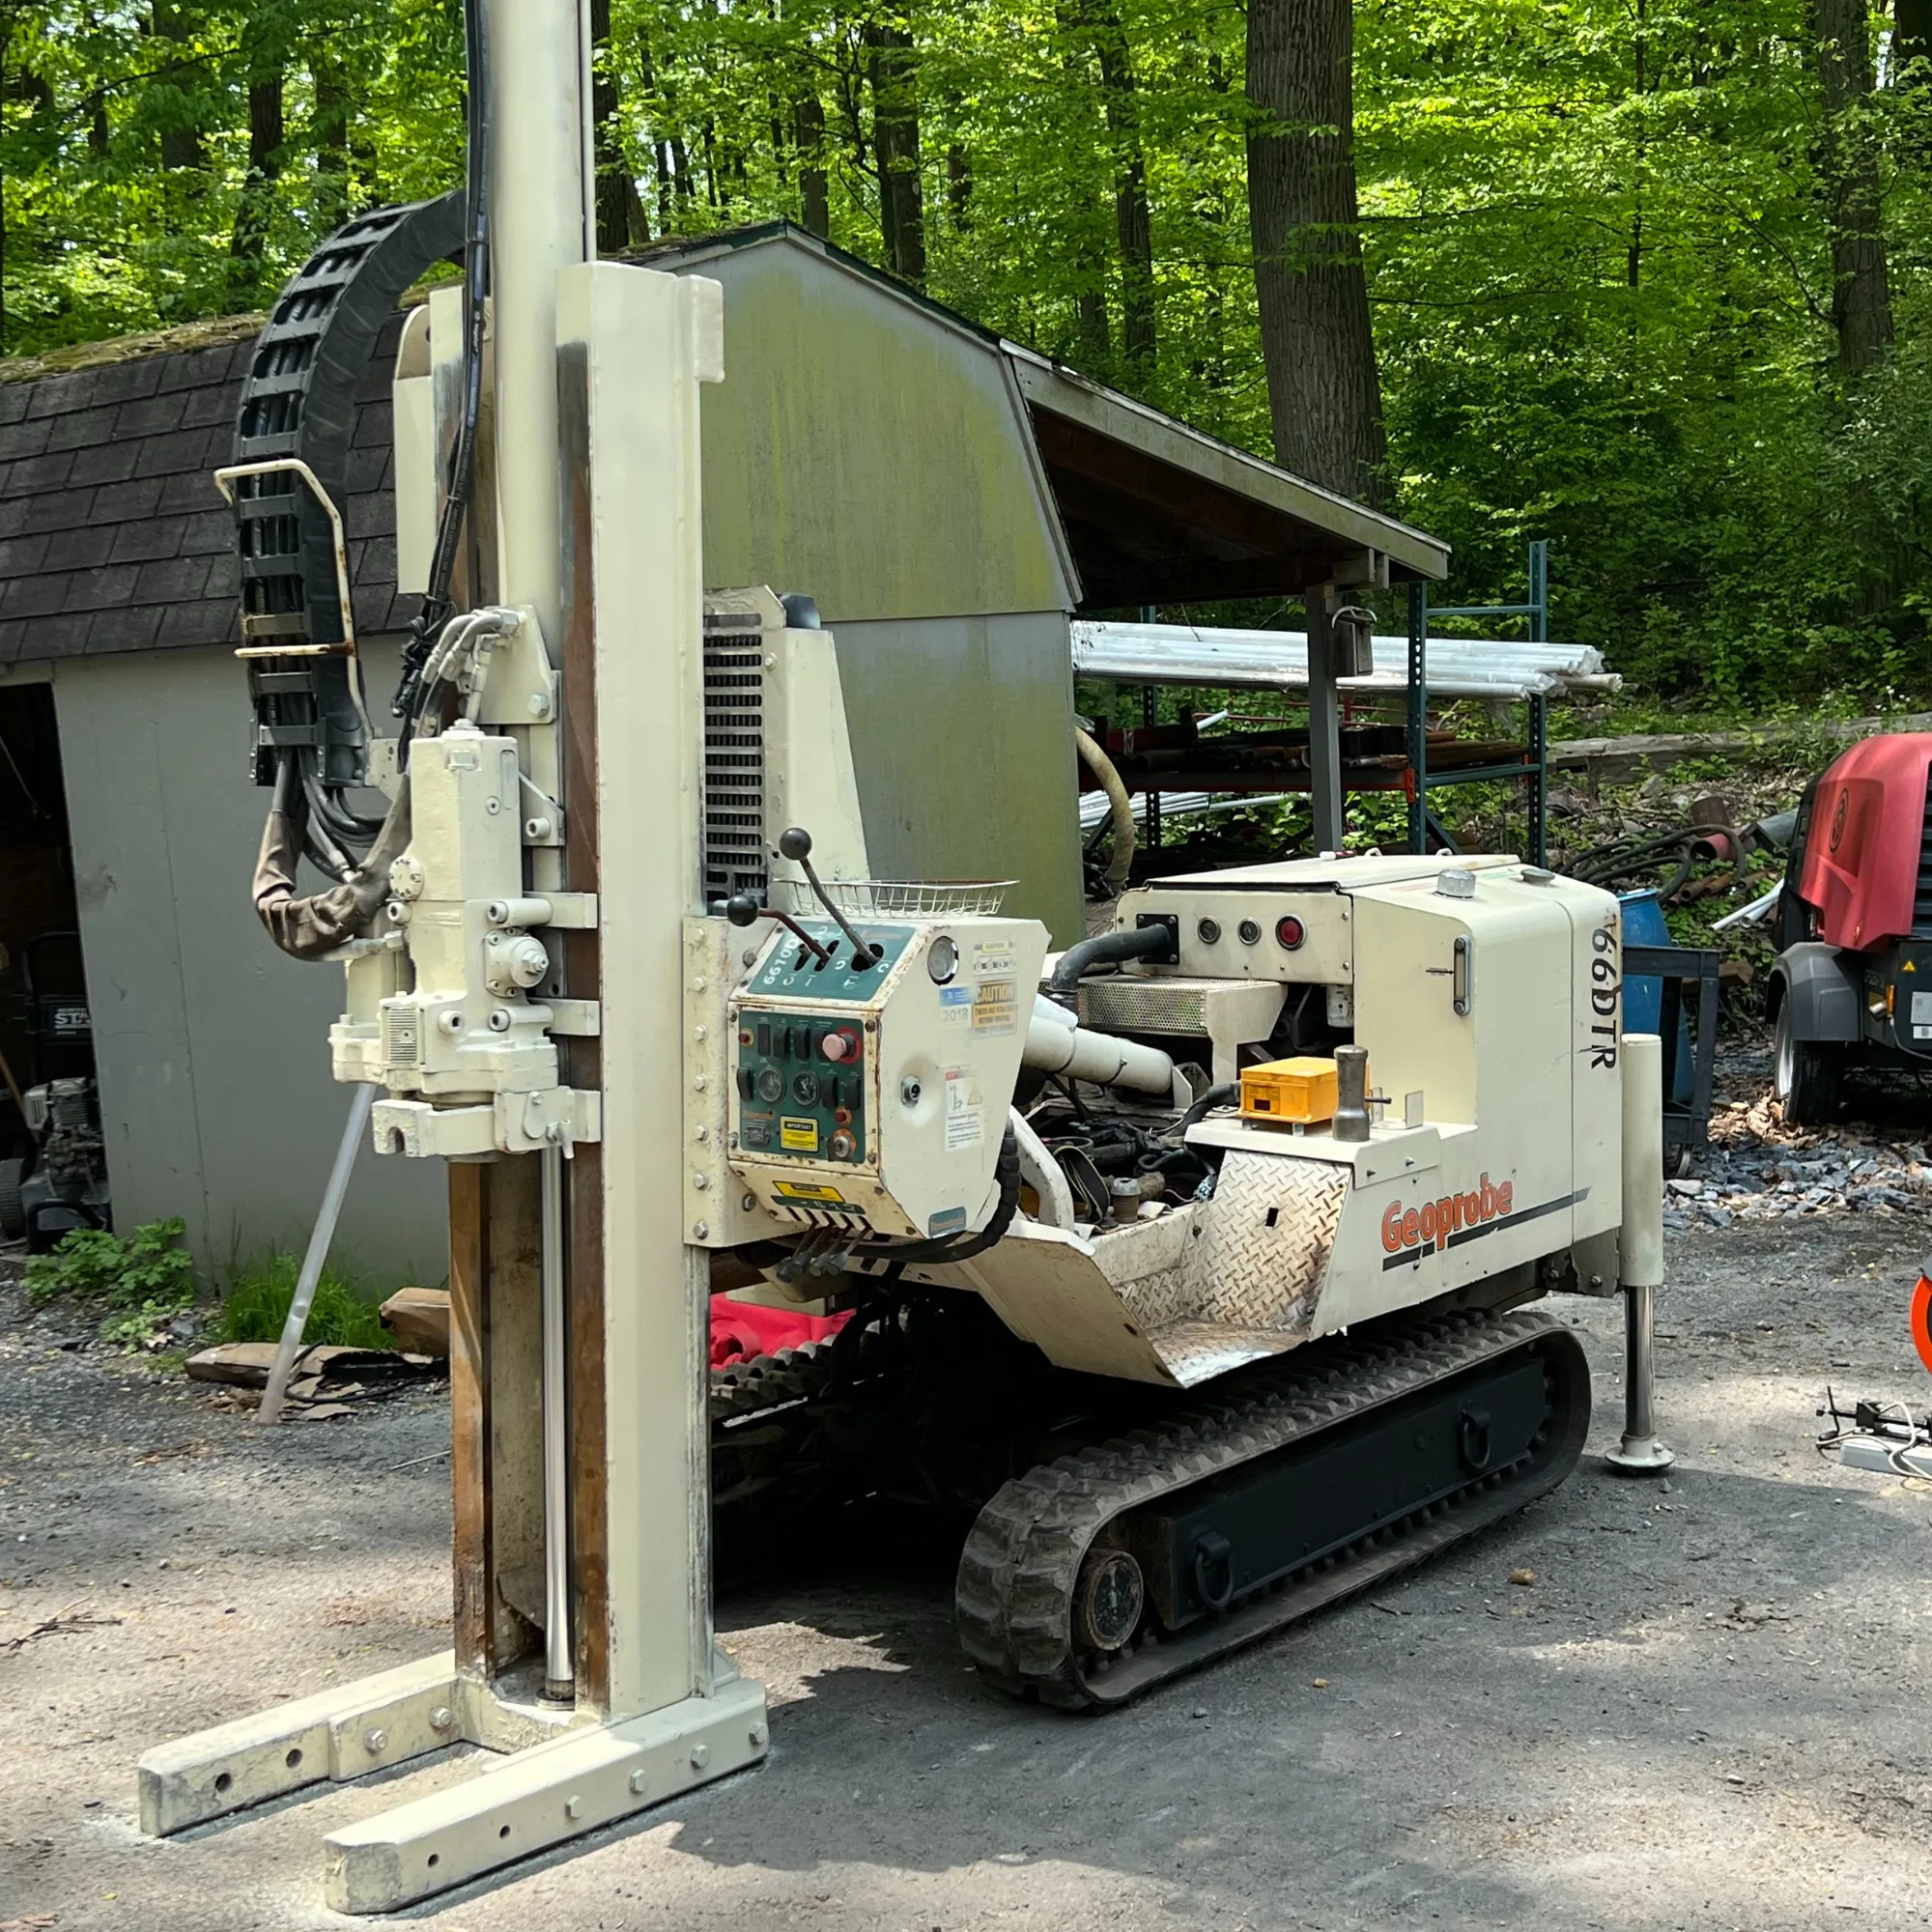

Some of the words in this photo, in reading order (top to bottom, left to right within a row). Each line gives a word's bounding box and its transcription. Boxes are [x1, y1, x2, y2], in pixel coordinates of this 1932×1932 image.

[762, 933, 801, 985] 6610D
[976, 984, 1014, 1004] CAUTION
[1591, 928, 1617, 1069] 66DTR
[942, 1008, 969, 1023] 2018
[785, 1122, 812, 1131] IMPORTANT
[1381, 1172, 1514, 1254] Geoprobe
